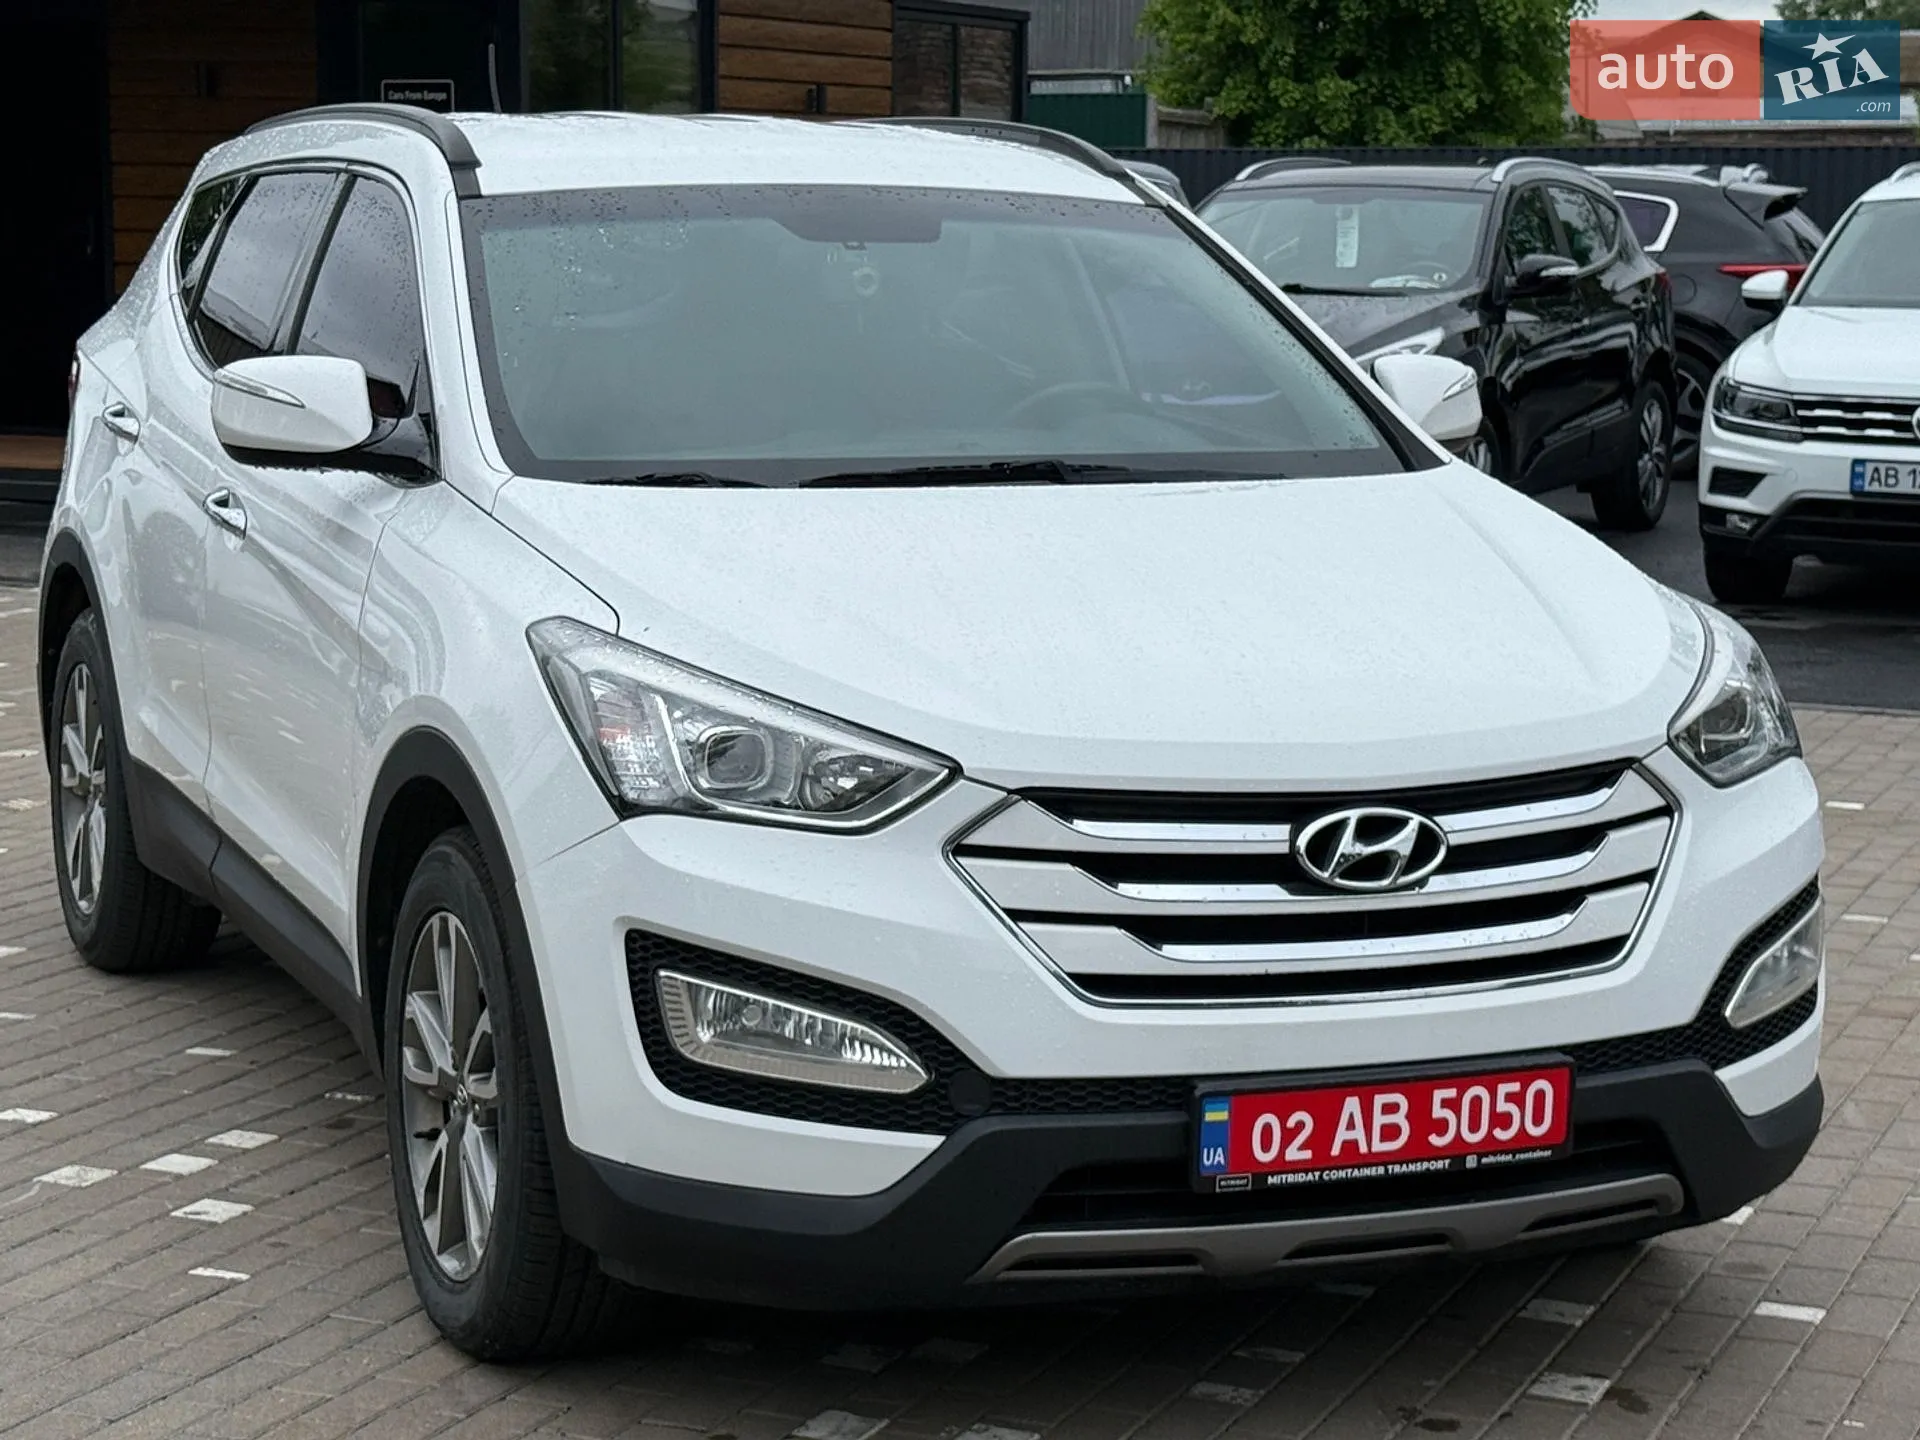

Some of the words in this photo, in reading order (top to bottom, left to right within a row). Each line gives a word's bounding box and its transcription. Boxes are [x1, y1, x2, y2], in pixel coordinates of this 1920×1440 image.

[1868, 466, 1900, 489] AB
[1907, 467, 1920, 489] 1
[1251, 1110, 1314, 1164] 02
[1330, 1092, 1411, 1158] AB
[1427, 1078, 1555, 1149] 5050
[1202, 1147, 1226, 1166] UA
[1267, 1170, 1320, 1186] MITRIDAT
[1322, 1165, 1385, 1181] CONTAINER
[1387, 1158, 1451, 1175] TRANSPORT
